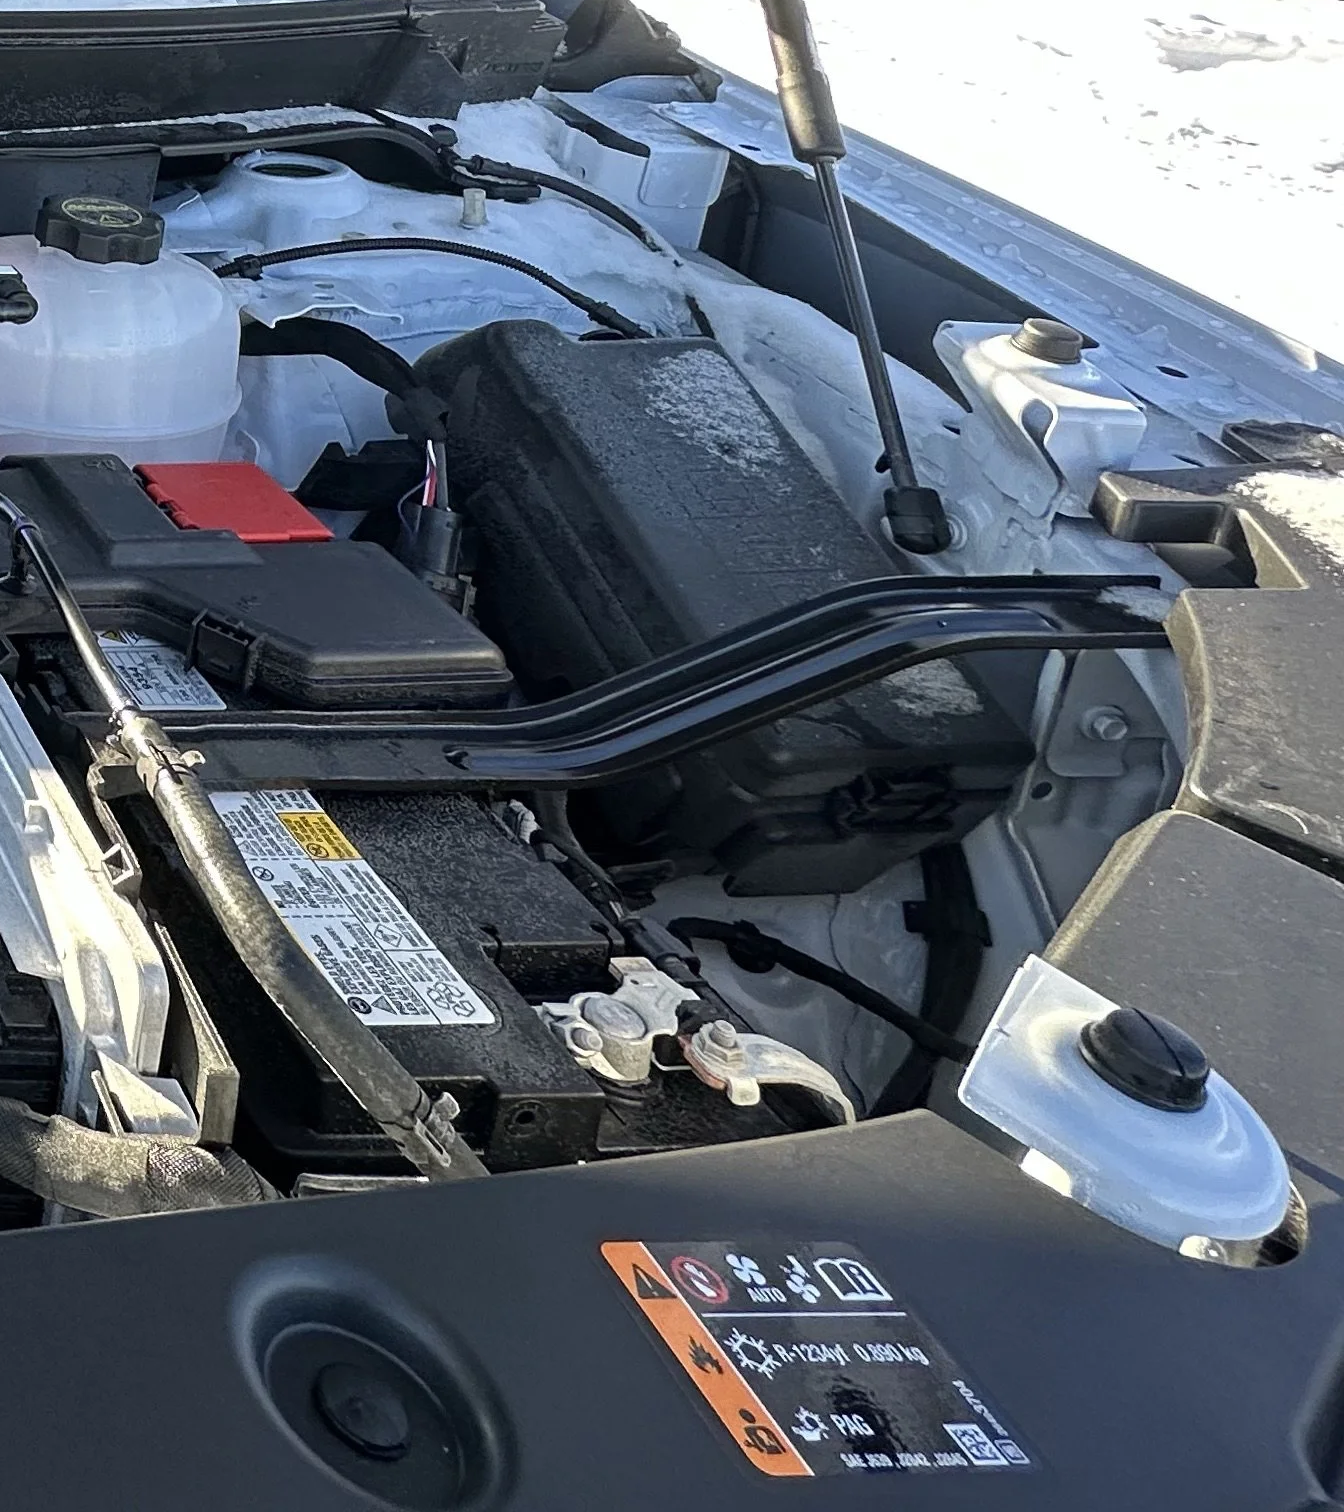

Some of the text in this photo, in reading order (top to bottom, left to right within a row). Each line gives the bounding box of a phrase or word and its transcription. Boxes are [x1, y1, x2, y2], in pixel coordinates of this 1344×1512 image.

[746, 1287, 787, 1303] AUTO
[772, 1343, 930, 1366] R-1234yf 0.890 kg
[830, 1414, 875, 1436] PAG
